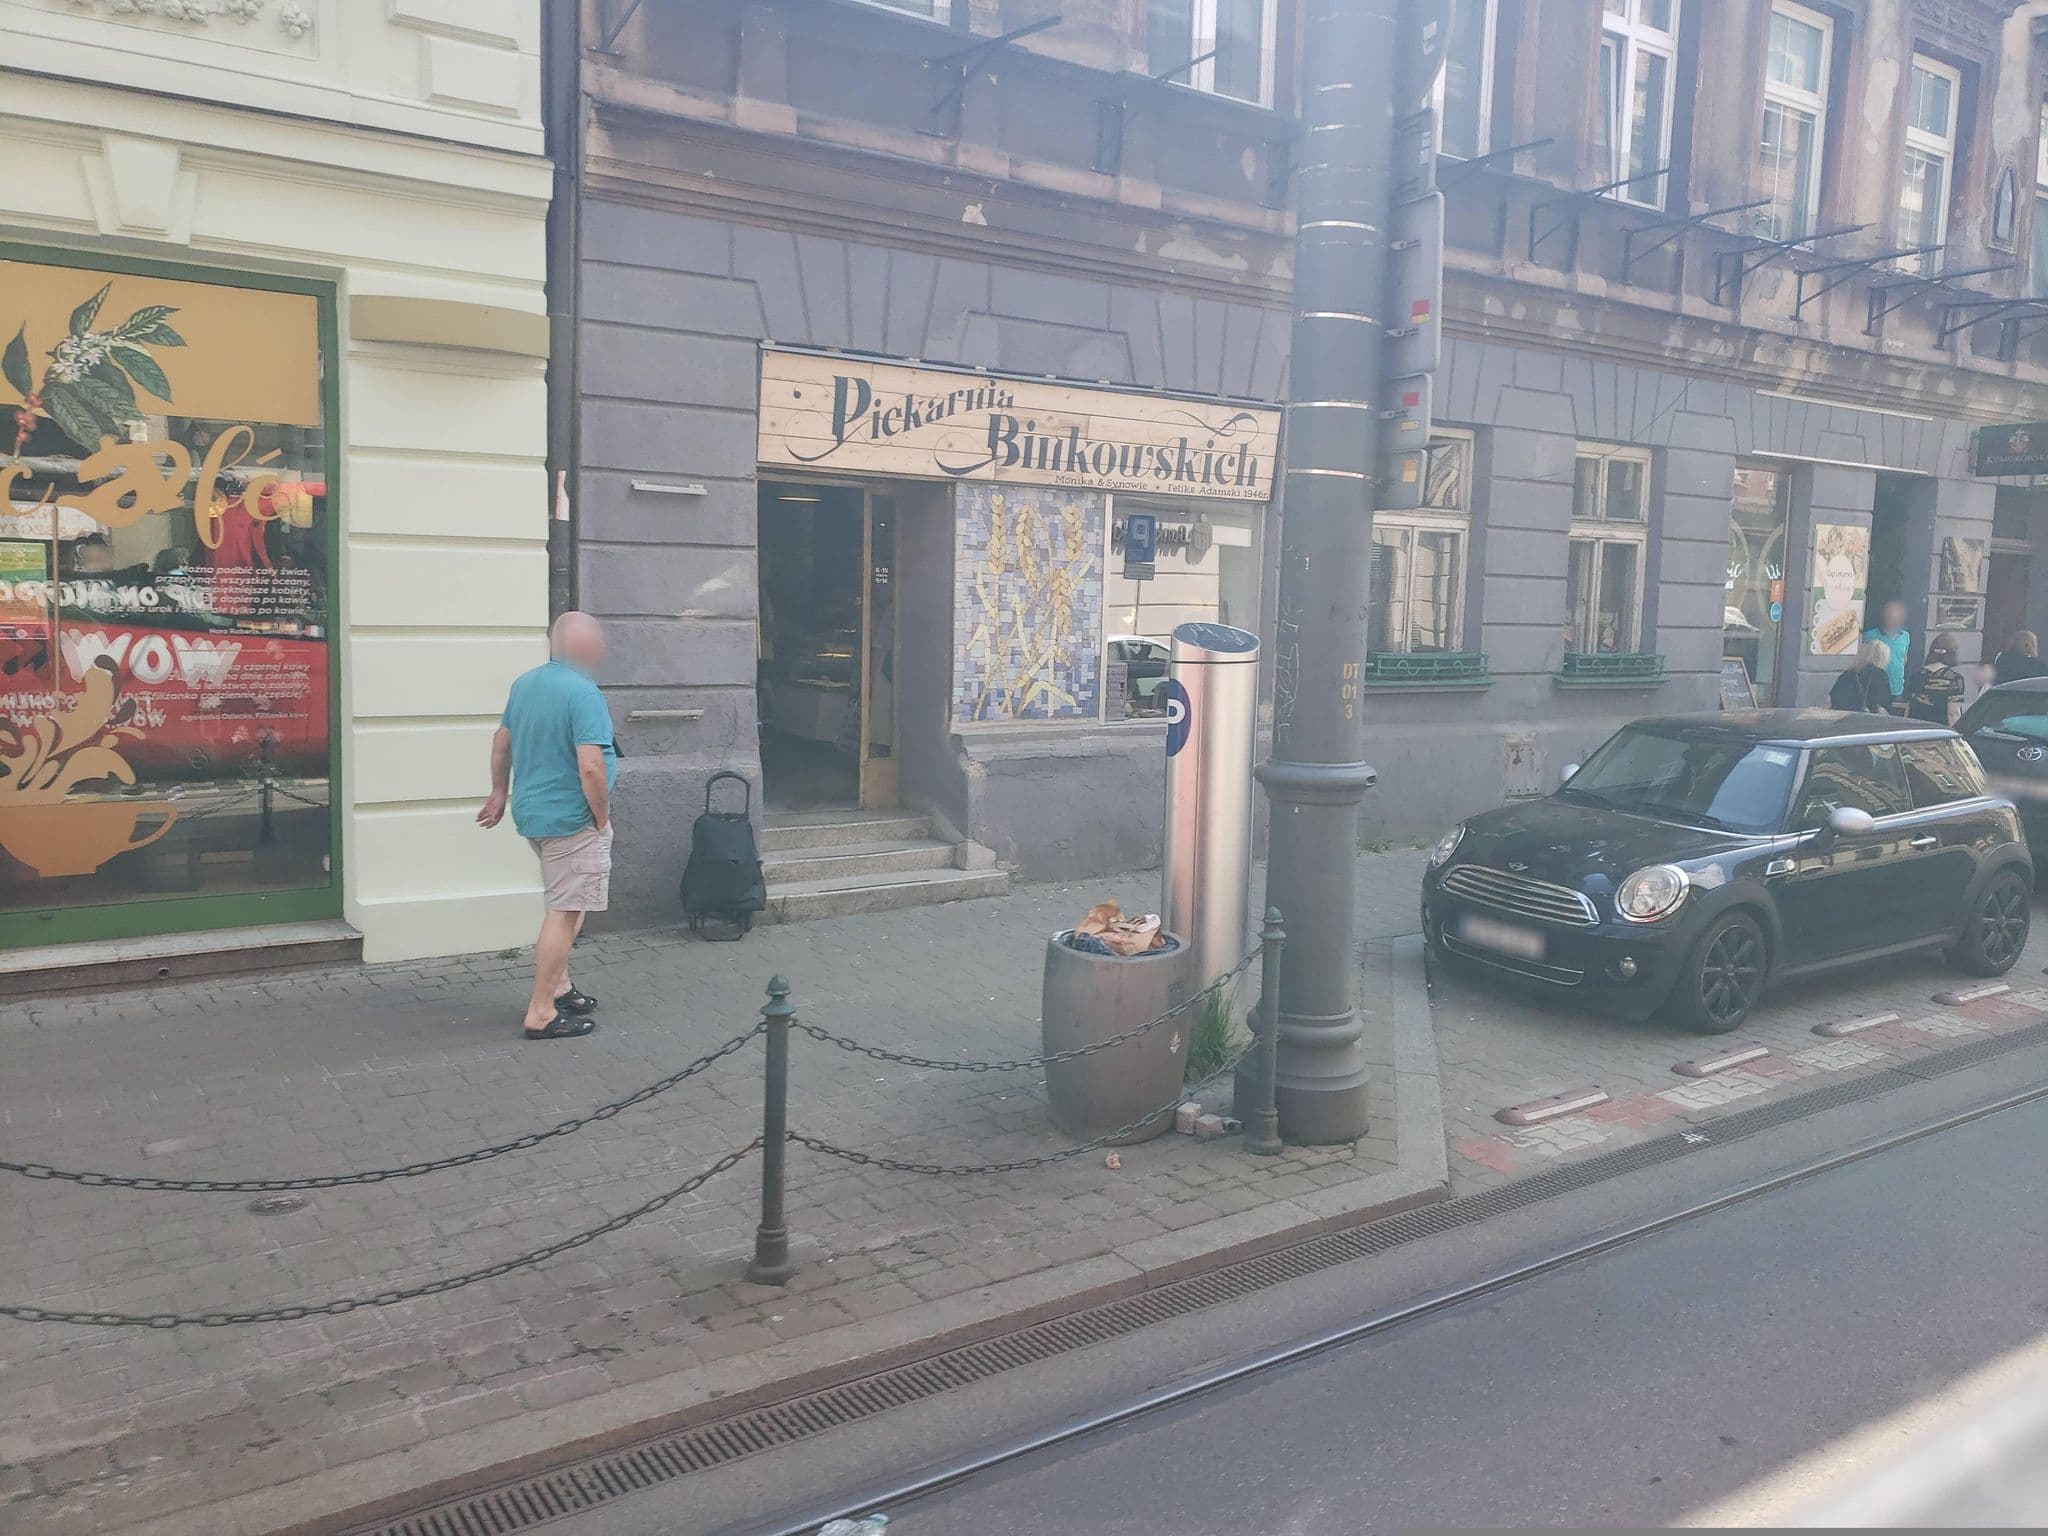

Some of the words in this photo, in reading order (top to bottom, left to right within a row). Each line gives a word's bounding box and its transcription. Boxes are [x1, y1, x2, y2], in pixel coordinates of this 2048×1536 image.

[785, 375, 1014, 461] Piekarnia
[934, 411, 1260, 487] Binkowskich
[1055, 475, 1094, 487] Monika
[1097, 478, 1104, 487] &
[1106, 479, 1148, 490] Synowie
[1168, 484, 1195, 494] Feliks
[1199, 486, 1241, 498] Adamski
[216, 565, 252, 576] podbić
[256, 566, 278, 577] cały
[219, 575, 270, 586] wszystkie
[219, 594, 259, 604] dopiero
[262, 597, 276, 606] po
[278, 595, 310, 605] kawie.
[229, 605, 256, 616] tylko
[259, 607, 273, 616] po
[243, 662, 280, 672] czarnej
[283, 662, 310, 672] kawy
[1343, 663, 1361, 679] DT
[241, 672, 262, 681] dnie
[248, 681, 266, 690] dla
[1344, 704, 1353, 720] 3
